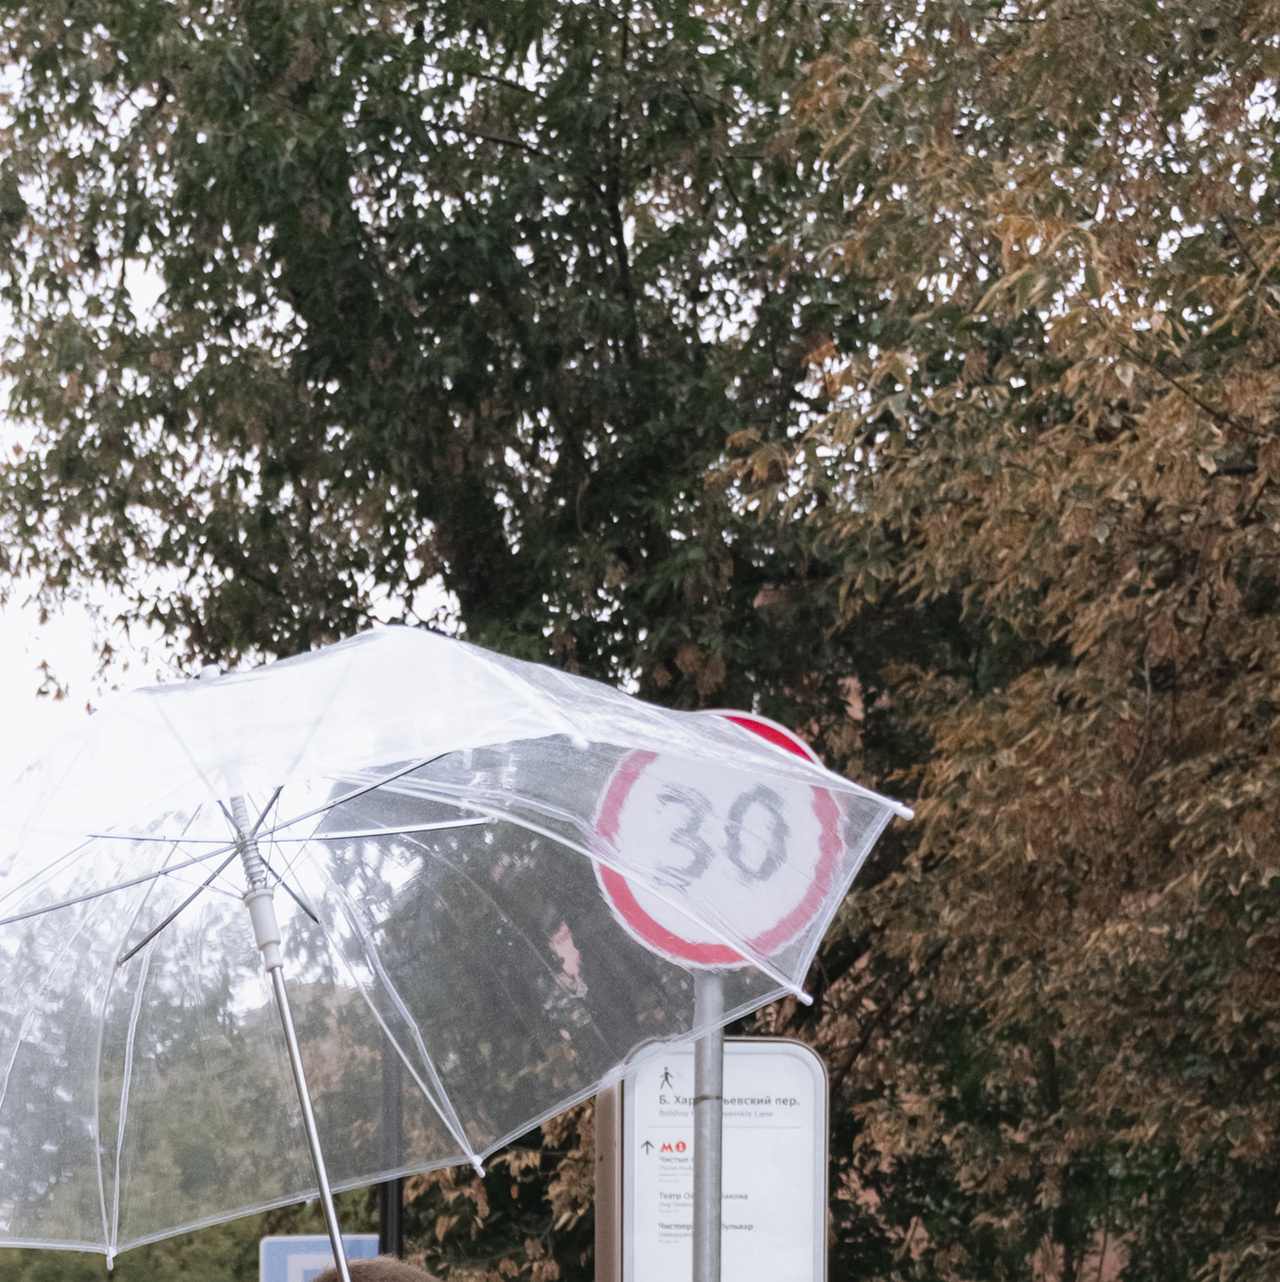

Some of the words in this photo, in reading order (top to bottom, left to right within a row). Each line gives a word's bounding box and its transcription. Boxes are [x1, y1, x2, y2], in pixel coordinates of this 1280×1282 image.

[653, 783, 790, 892] 30
[658, 1094, 670, 1105] Б.
[674, 1095, 771, 1107] Харьевский
[775, 1097, 800, 1107] пер.
[659, 1192, 682, 1200] Театр
